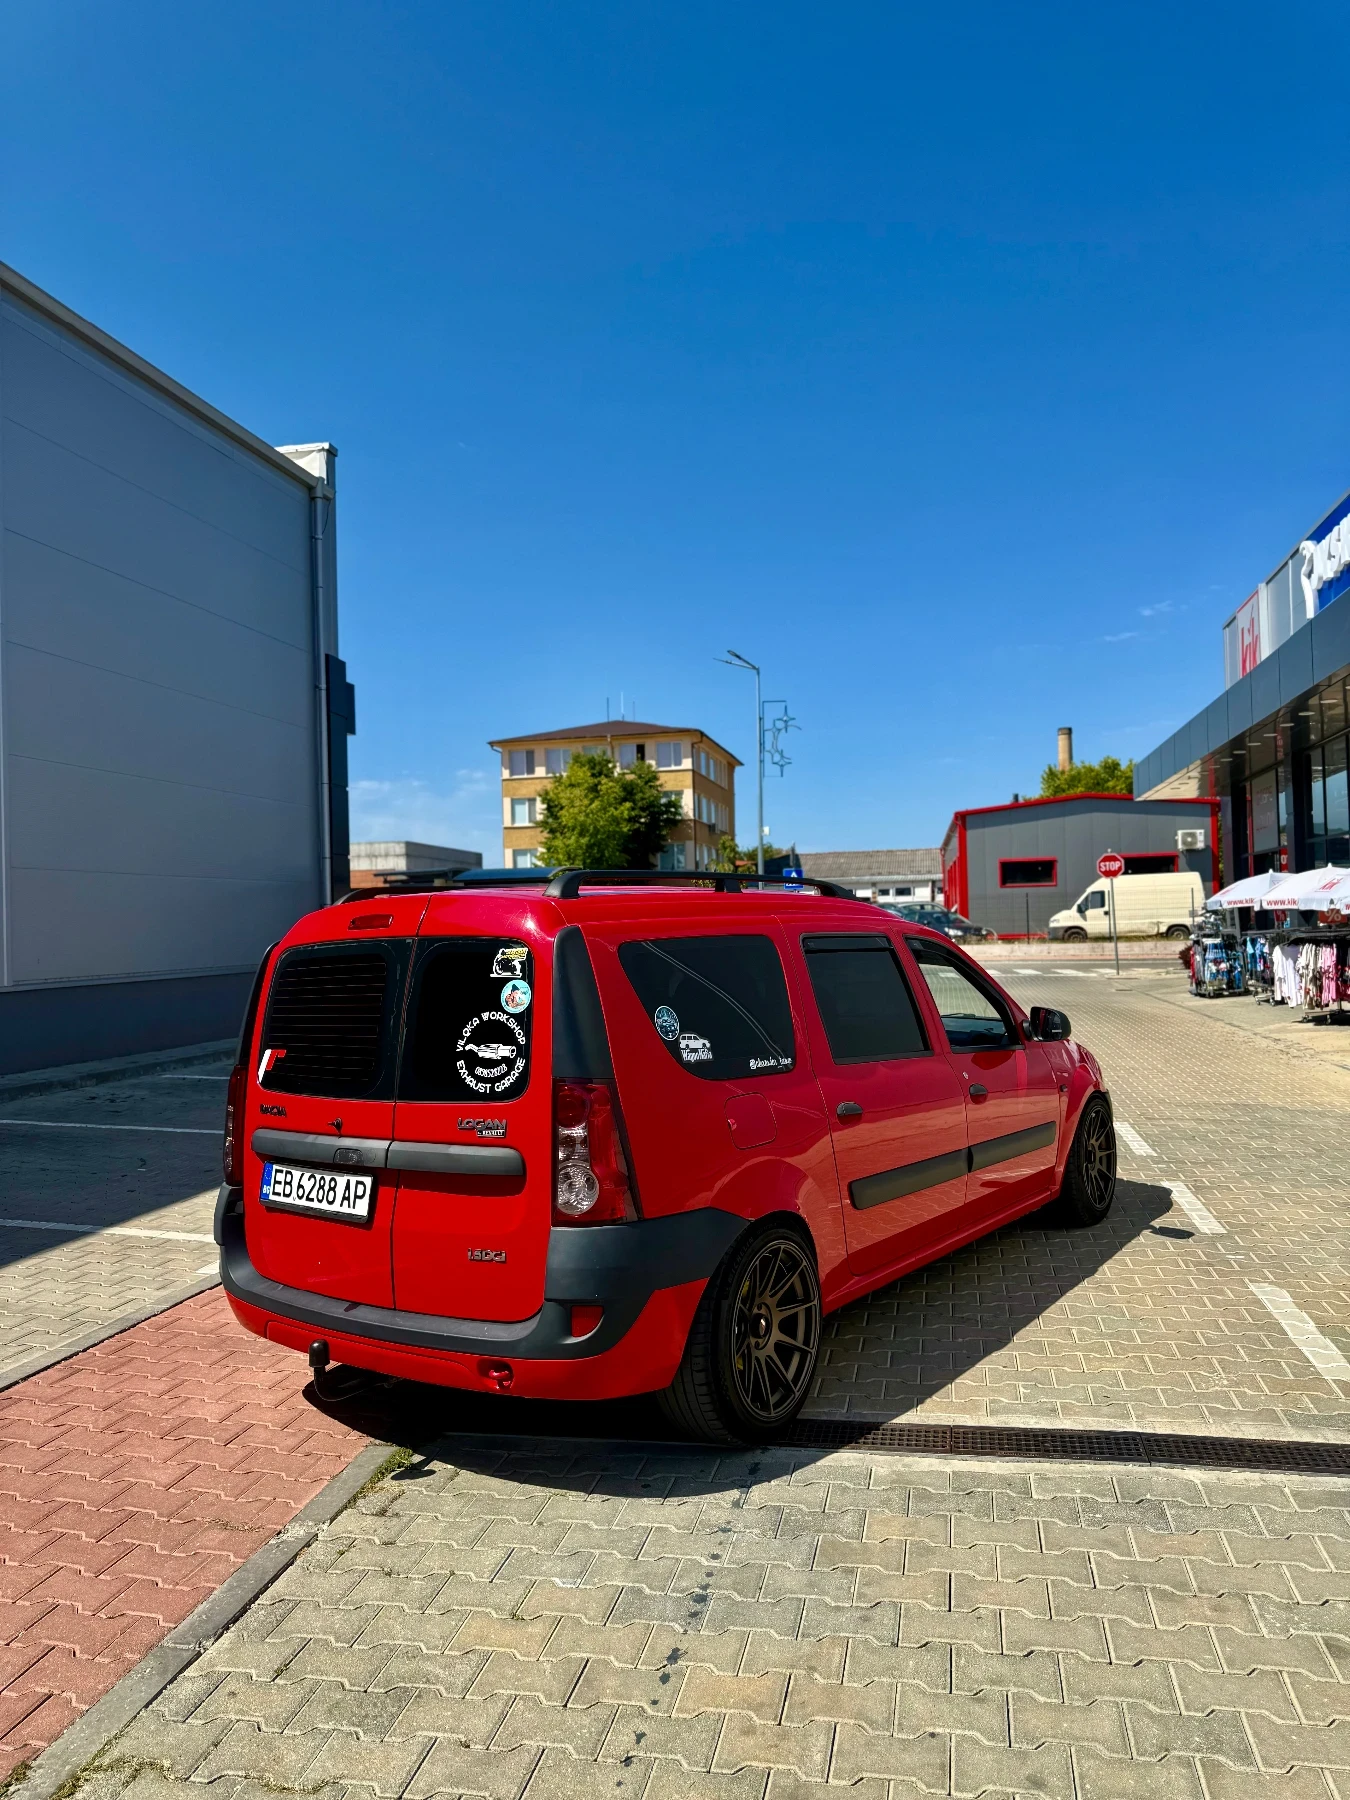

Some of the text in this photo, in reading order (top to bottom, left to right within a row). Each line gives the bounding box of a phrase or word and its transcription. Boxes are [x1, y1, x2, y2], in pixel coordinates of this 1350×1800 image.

[1100, 861, 1121, 871] STOP
[481, 1011, 526, 1045] WORKSHOP
[456, 1056, 526, 1094] EXHAUST GARAGE
[458, 1118, 506, 1130] LOGAN
[272, 1169, 367, 1210] EB 6288 AP
